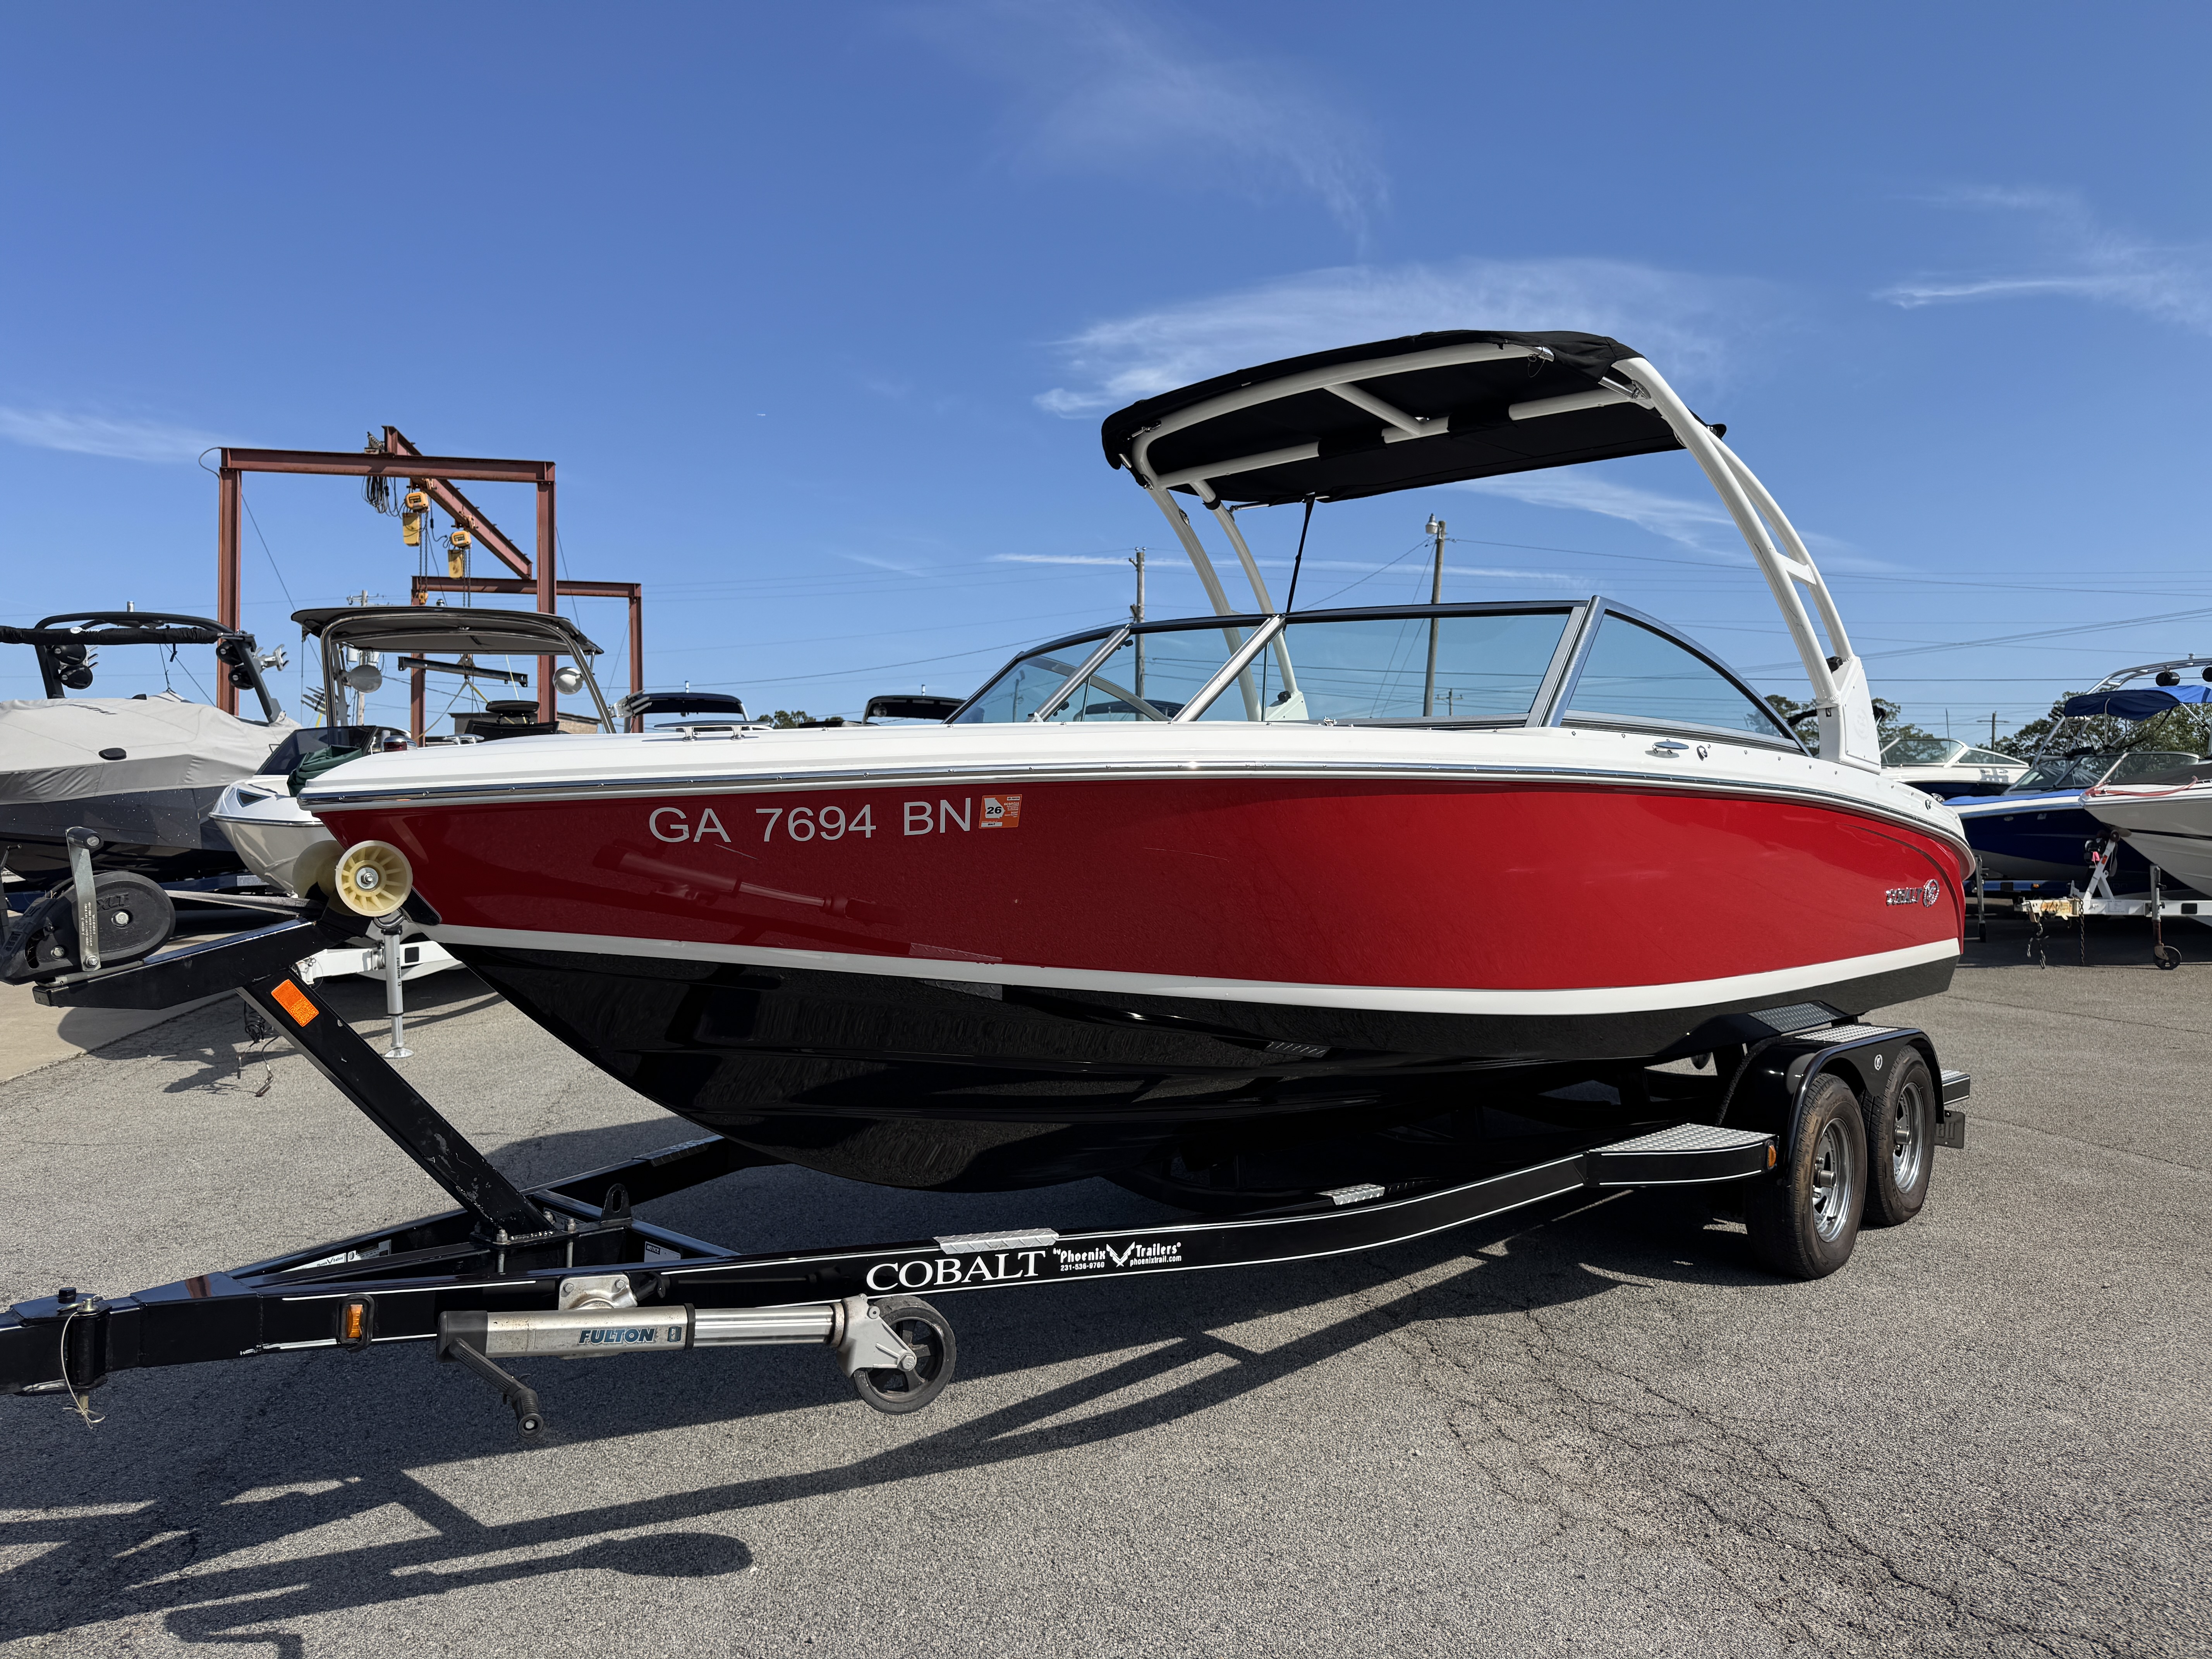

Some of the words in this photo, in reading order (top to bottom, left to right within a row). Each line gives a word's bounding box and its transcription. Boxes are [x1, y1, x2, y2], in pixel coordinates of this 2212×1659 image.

[649, 807, 732, 842] GA
[756, 804, 876, 842] 7694
[904, 797, 971, 836] BN
[1060, 1247, 1106, 1263] Phoenix
[1130, 1255, 1182, 1267] phoenixtrail.com
[866, 1250, 1046, 1291] COBALT
[578, 1328, 656, 1345] FULTON
